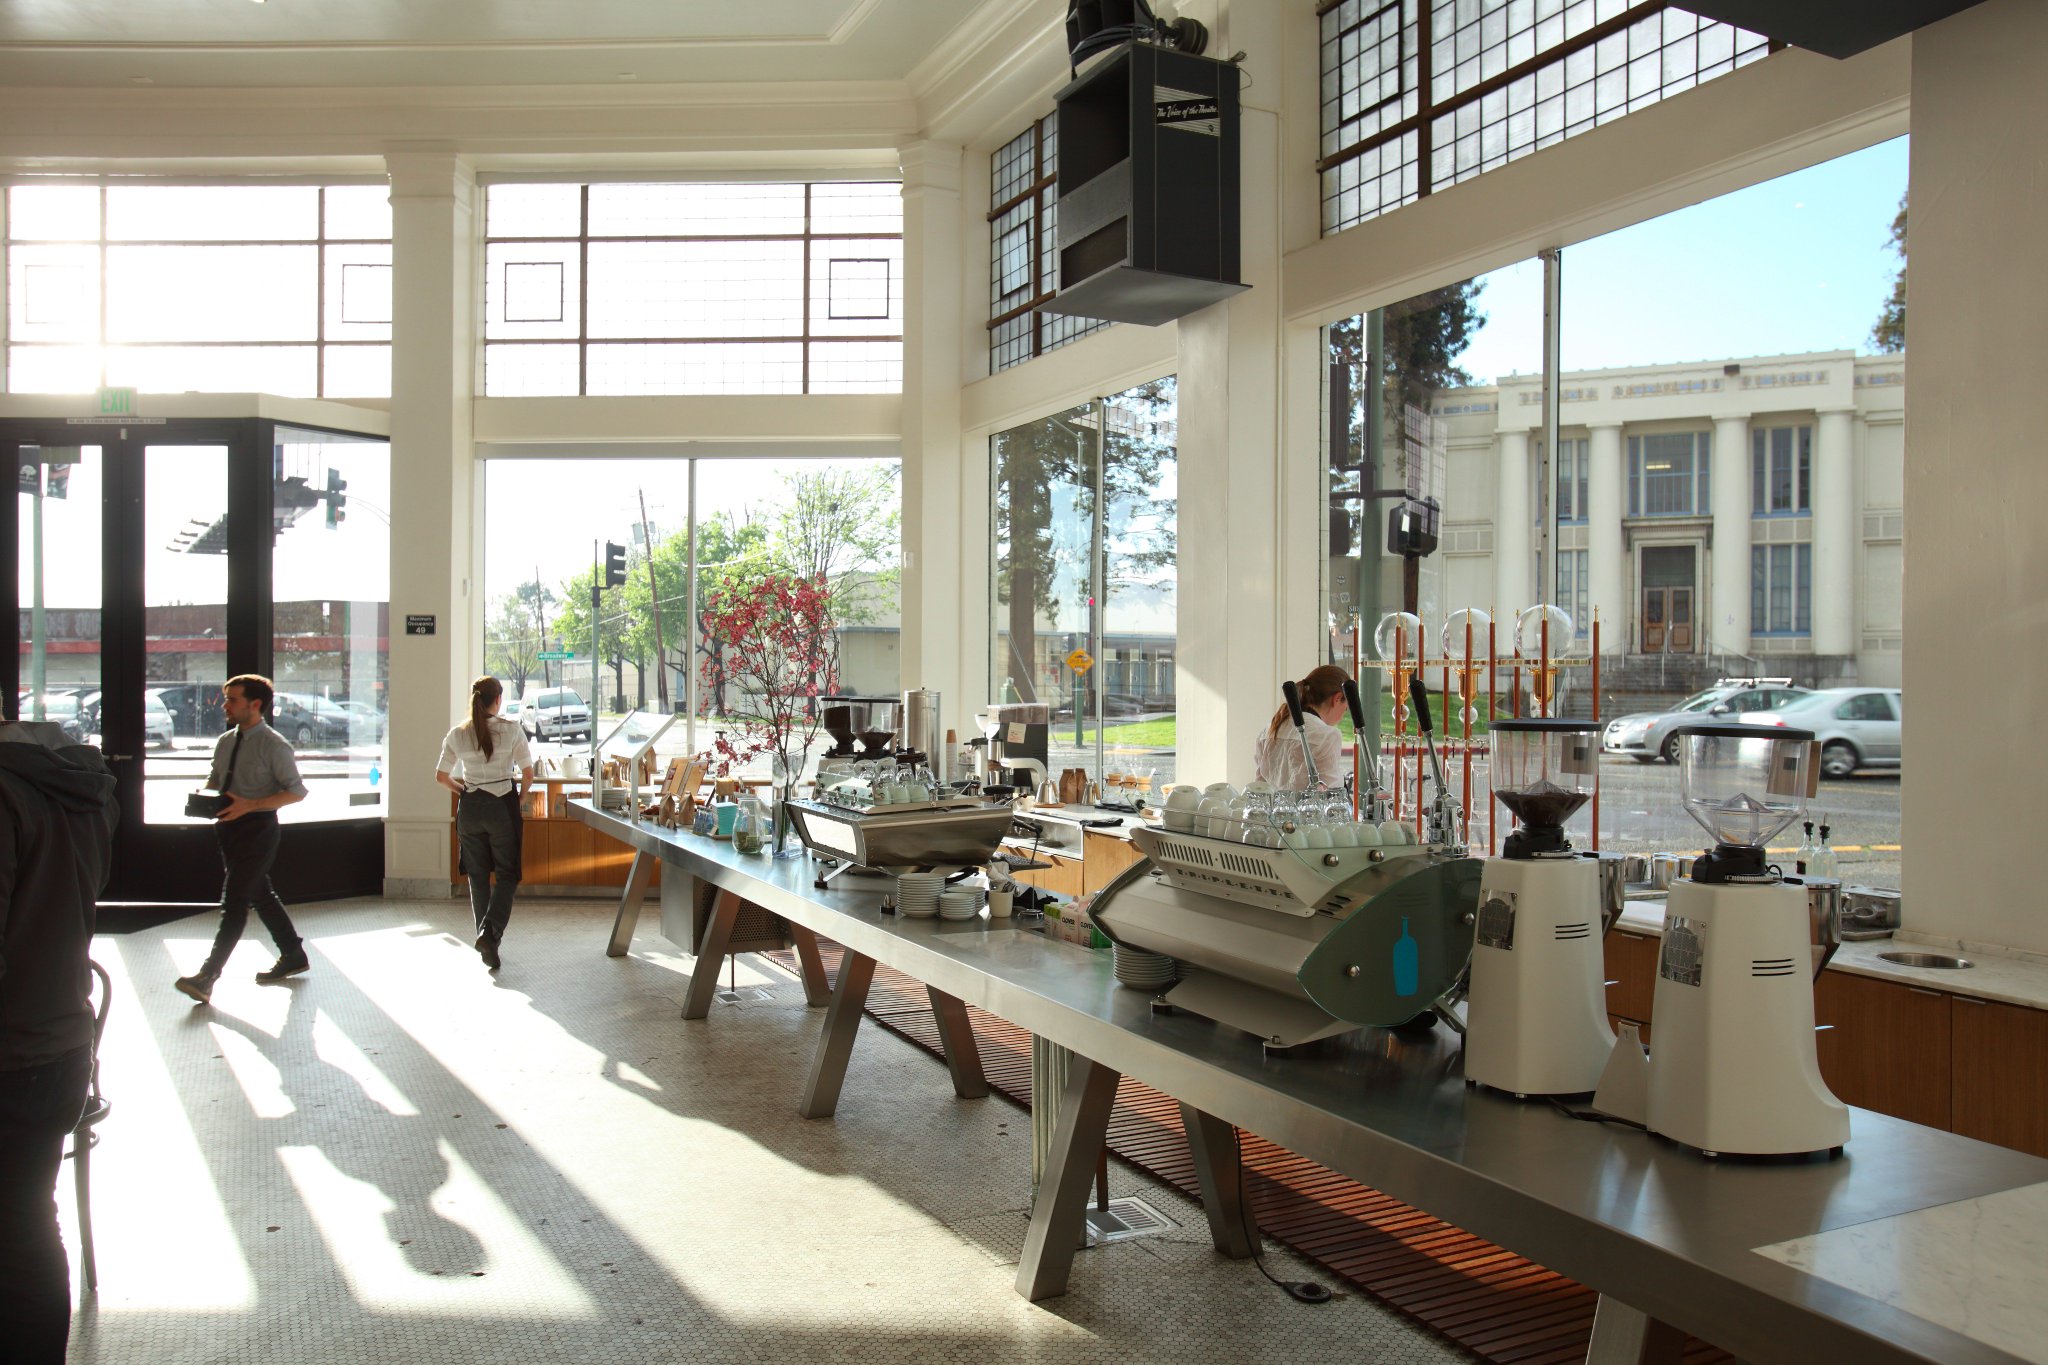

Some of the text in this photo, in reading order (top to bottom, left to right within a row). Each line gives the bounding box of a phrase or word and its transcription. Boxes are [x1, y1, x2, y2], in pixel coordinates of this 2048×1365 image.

[1157, 107, 1166, 117] The
[1167, 104, 1181, 117] Voice
[1182, 106, 1189, 118] of
[1189, 106, 1198, 114] the
[101, 391, 130, 413] EXIT
[416, 626, 426, 634] 49
[1062, 917, 1075, 925] CLOVER
